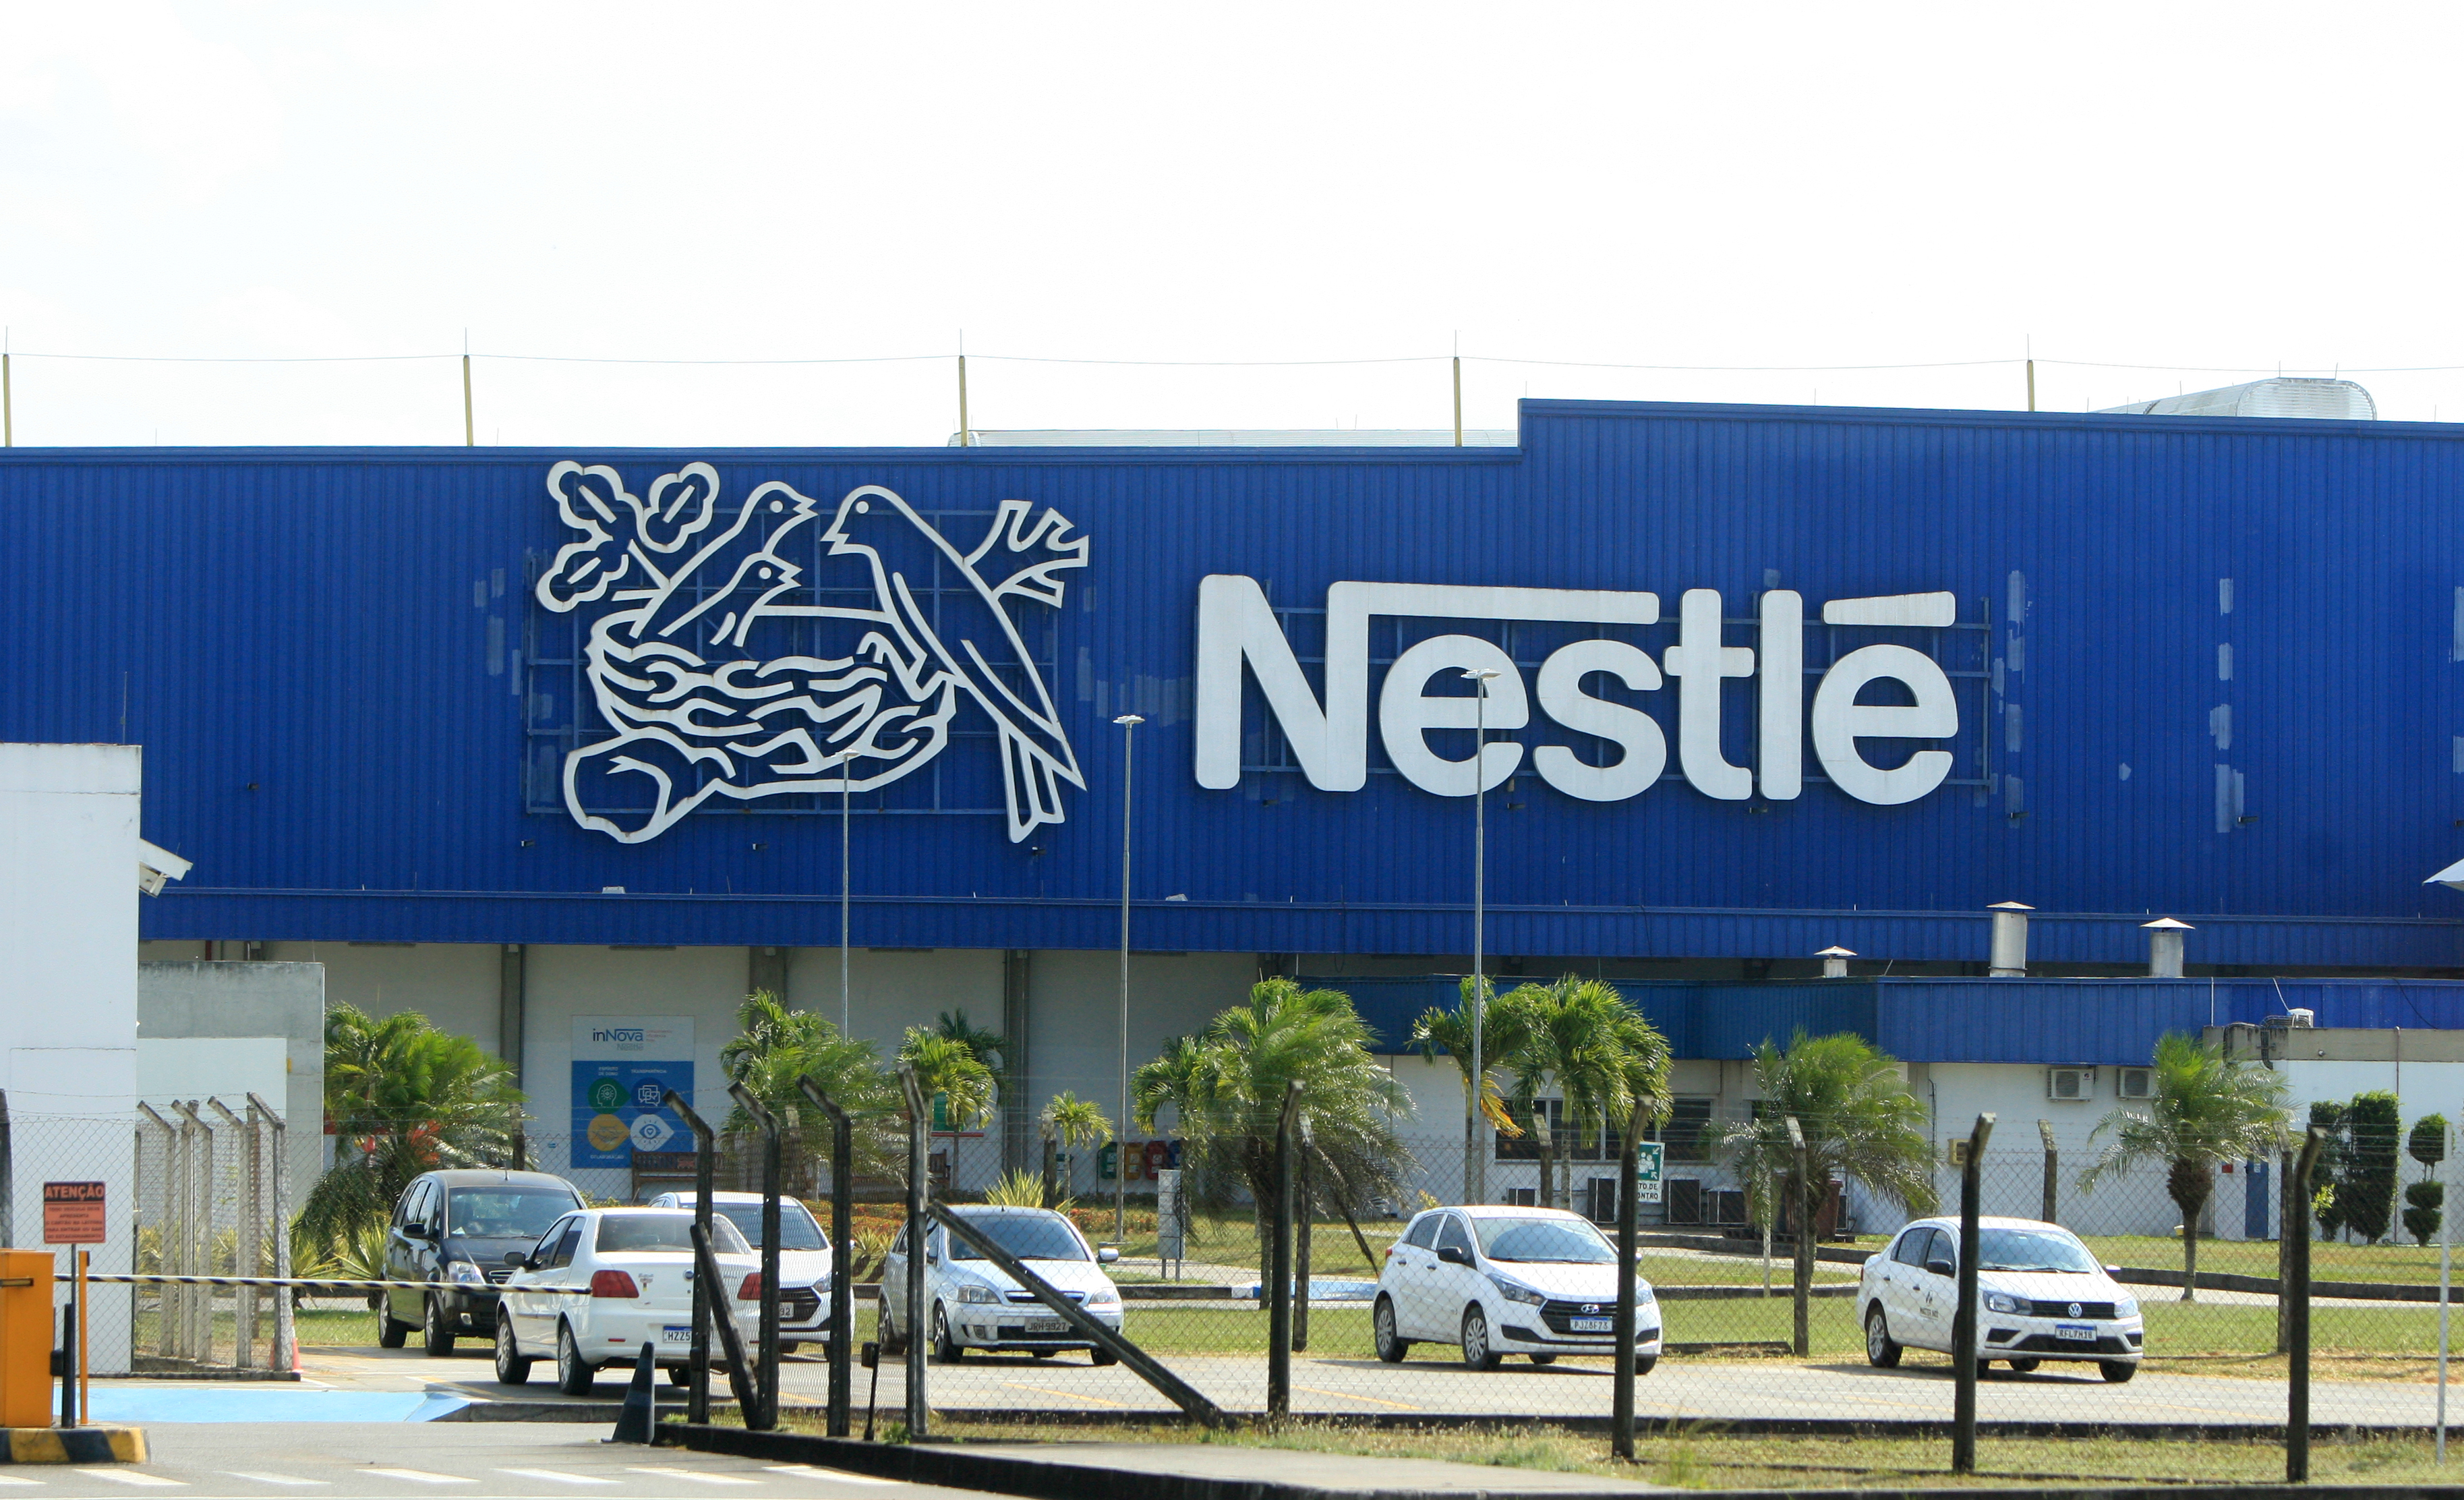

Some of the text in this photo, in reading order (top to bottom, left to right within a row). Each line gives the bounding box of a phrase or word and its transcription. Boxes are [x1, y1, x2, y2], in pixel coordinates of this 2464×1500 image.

[1194, 574, 1959, 805] Nestlé
[593, 1029, 644, 1041] inNova
[45, 1184, 104, 1201] ATENÇÃO
[668, 1331, 691, 1342] HZZ5
